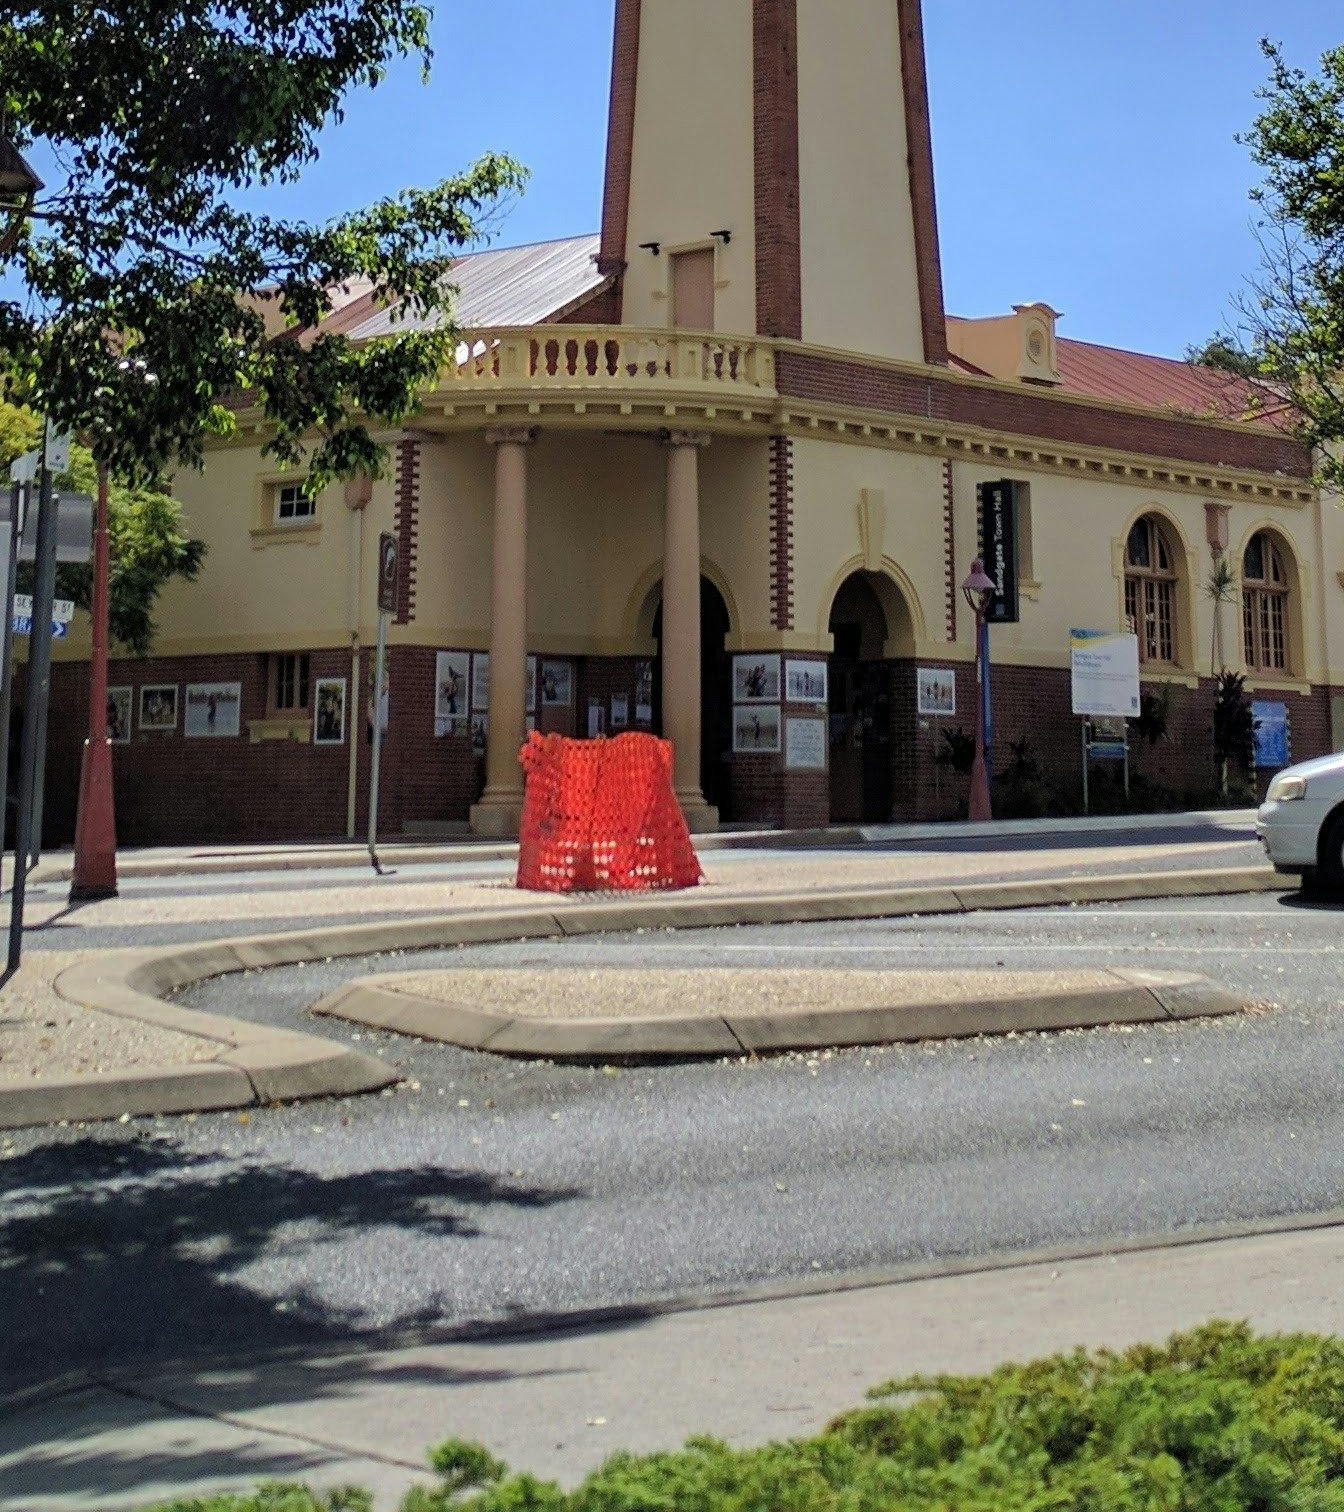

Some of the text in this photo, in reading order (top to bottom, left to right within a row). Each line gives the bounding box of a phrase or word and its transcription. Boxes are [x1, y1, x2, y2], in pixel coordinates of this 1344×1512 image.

[992, 490, 1005, 596] Sandgate Town Hall
